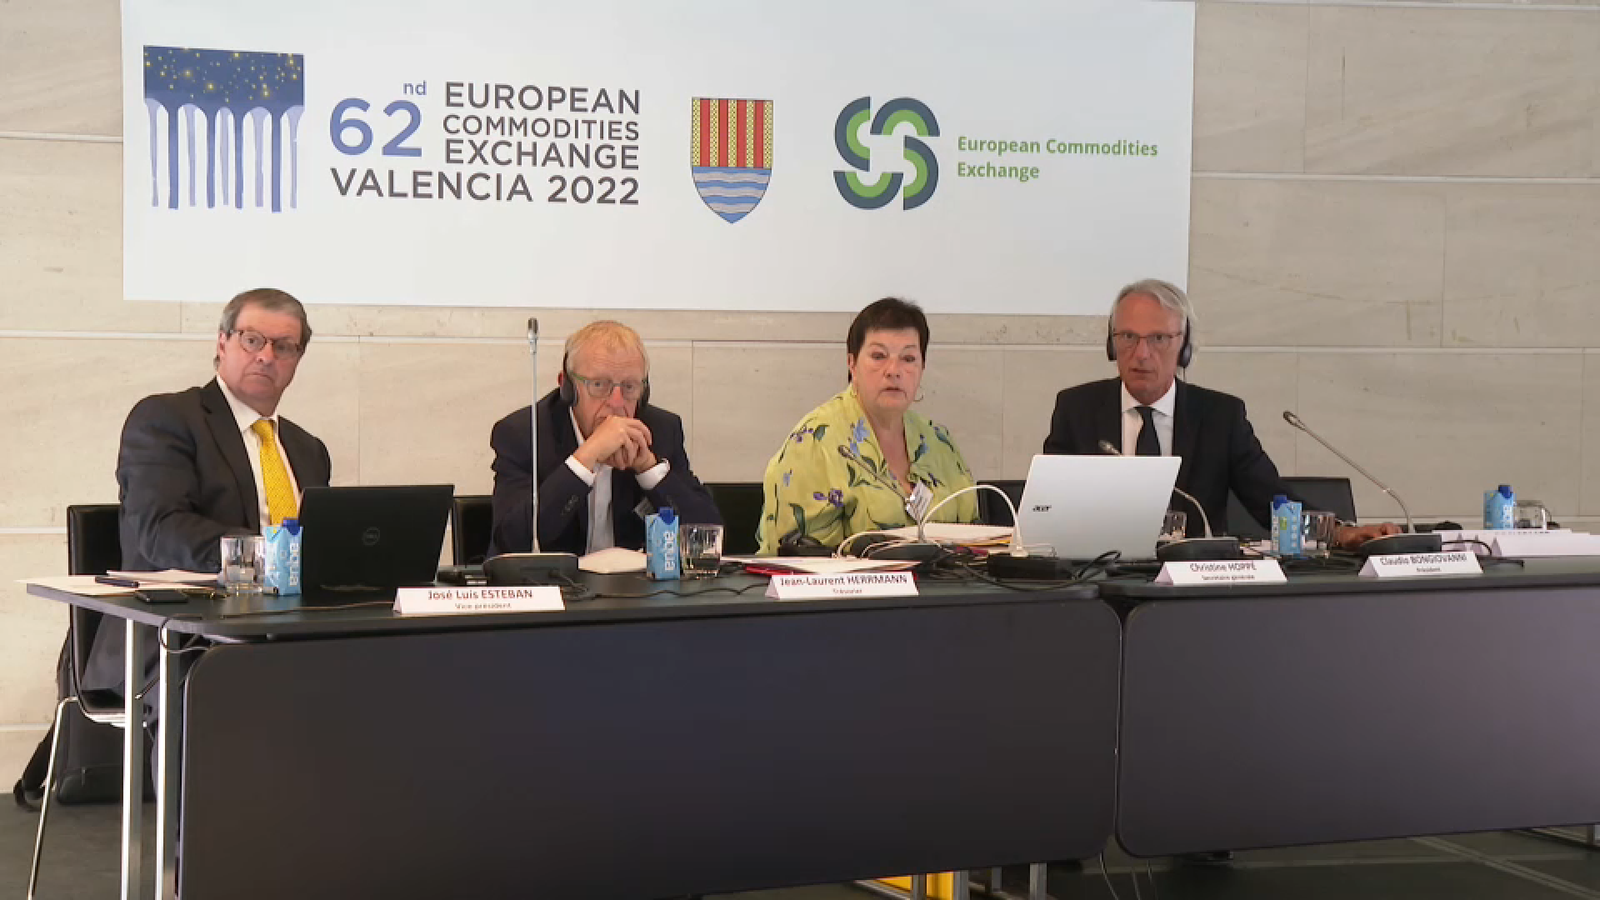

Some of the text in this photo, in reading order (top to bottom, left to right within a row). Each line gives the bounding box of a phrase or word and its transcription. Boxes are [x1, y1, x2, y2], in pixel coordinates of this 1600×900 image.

[445, 81, 640, 115] EUROPEAN
[329, 80, 427, 157] 62 nd
[442, 114, 640, 142] COMMODITIES
[445, 138, 640, 171] EXCHANGE
[957, 135, 1159, 157] European Commodities
[957, 161, 1041, 183] Exchange
[330, 167, 640, 206] VALENCIA 2022
[1032, 504, 1053, 513] acer
[661, 530, 675, 571] aqua
[1380, 553, 1468, 566] Claudio BONGIOVANNI
[1189, 563, 1227, 572] Christine
[780, 573, 908, 587] Jean-Laurent HERRMANN
[428, 588, 533, 600] José Luis ESTEBAN
